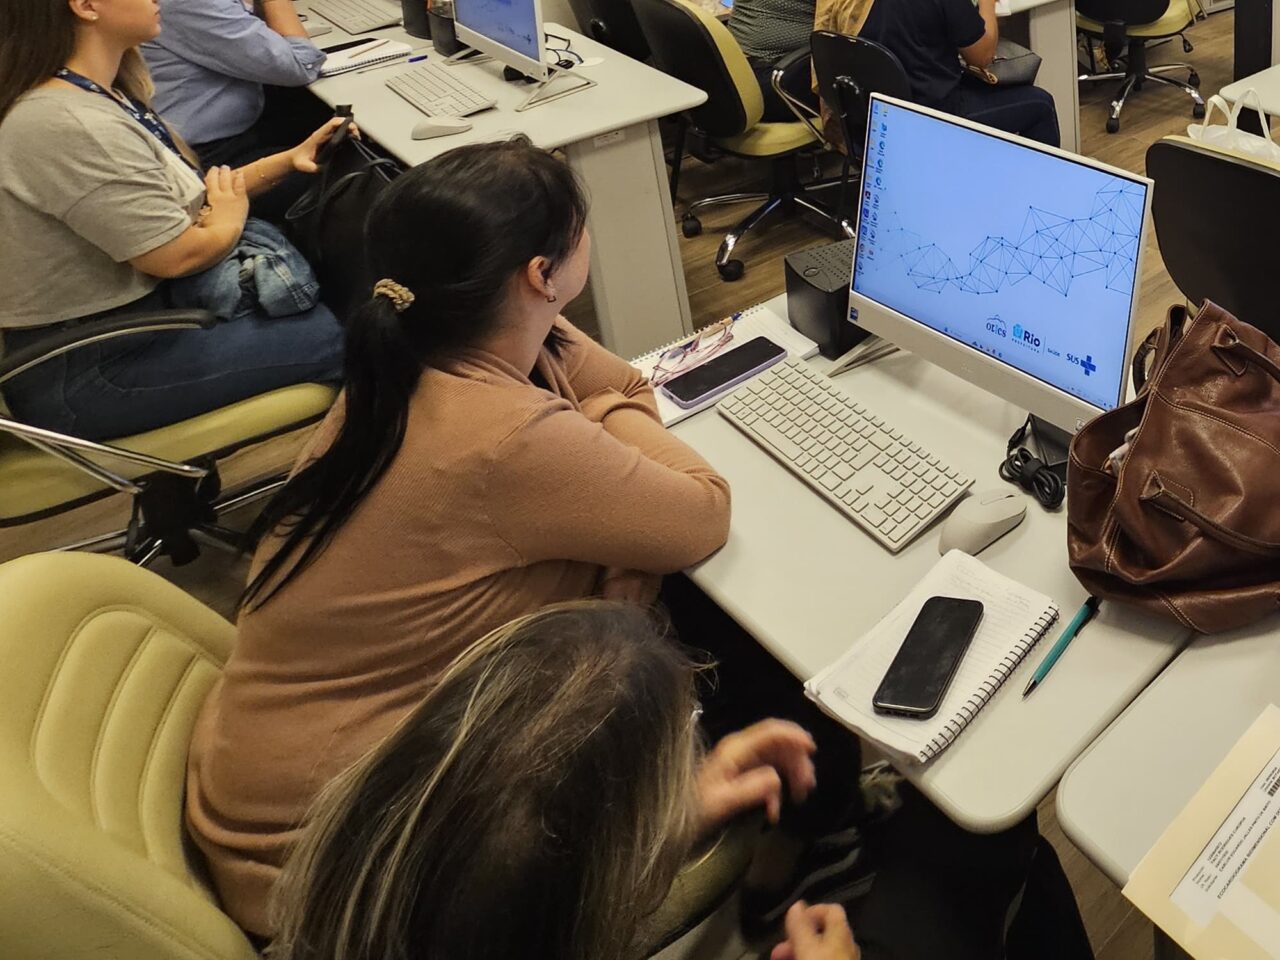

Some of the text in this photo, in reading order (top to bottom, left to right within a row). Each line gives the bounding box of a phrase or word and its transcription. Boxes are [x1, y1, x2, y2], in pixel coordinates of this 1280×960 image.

[986, 322, 1007, 338] otics
[1023, 330, 1041, 348] Rio
[1066, 352, 1080, 365] SUS
[1217, 857, 1248, 899] ECOCARDIOGRAMA
